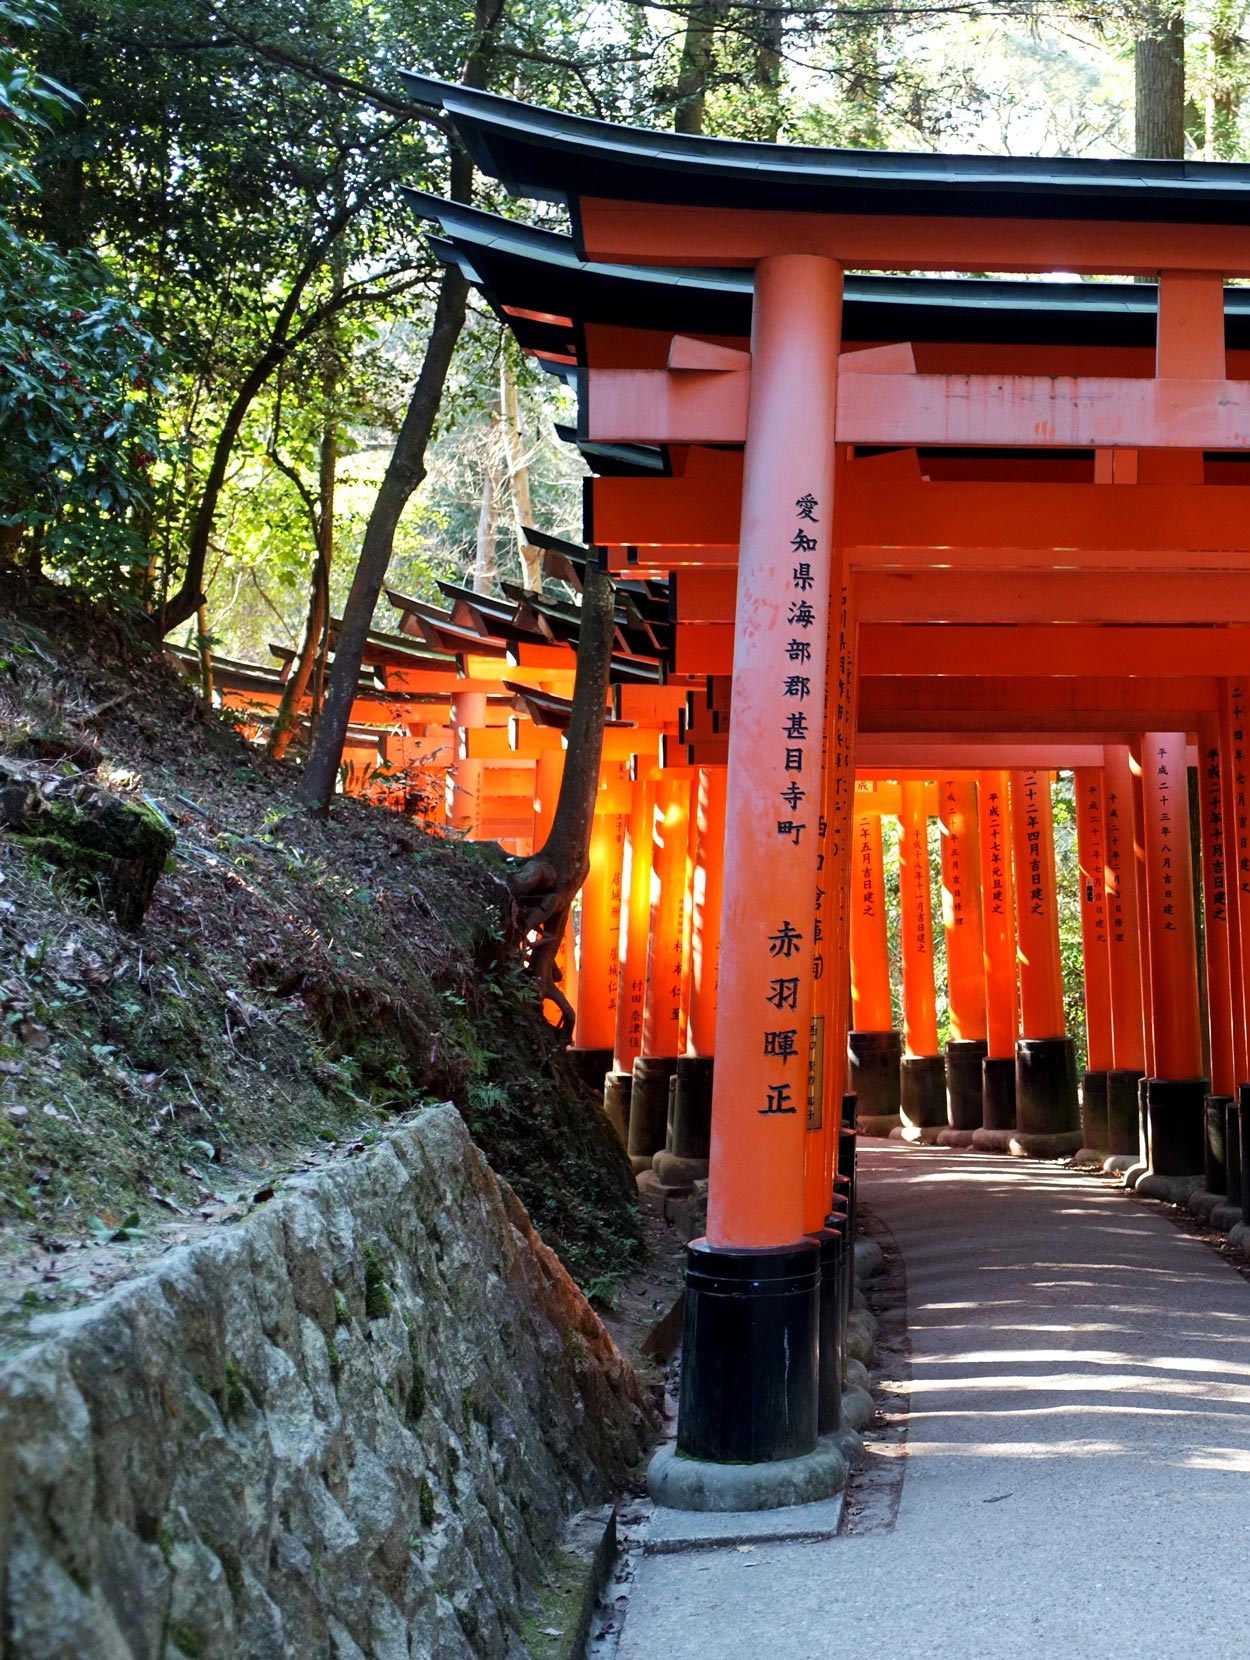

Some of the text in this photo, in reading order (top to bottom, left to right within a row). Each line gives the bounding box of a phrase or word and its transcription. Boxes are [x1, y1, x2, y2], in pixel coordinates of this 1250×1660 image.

[757, 493, 820, 1116] 愛知県海部郡甚目寺町 赤羽暉正
[988, 793, 1004, 915] 平成二十七年元旦建之
[1024, 771, 1045, 916] 二十二年四月吉日建之
[1088, 785, 1106, 943] 平成二十一年七月吉日建之
[1108, 793, 1125, 942] 平成二十年二月吉日修理
[1157, 747, 1176, 931] 平成二十三年八月吉日建之
[1206, 748, 1227, 921] 平成二十年十月吉日建之
[912, 829, 926, 953] 平成十八年十一月吉日建之
